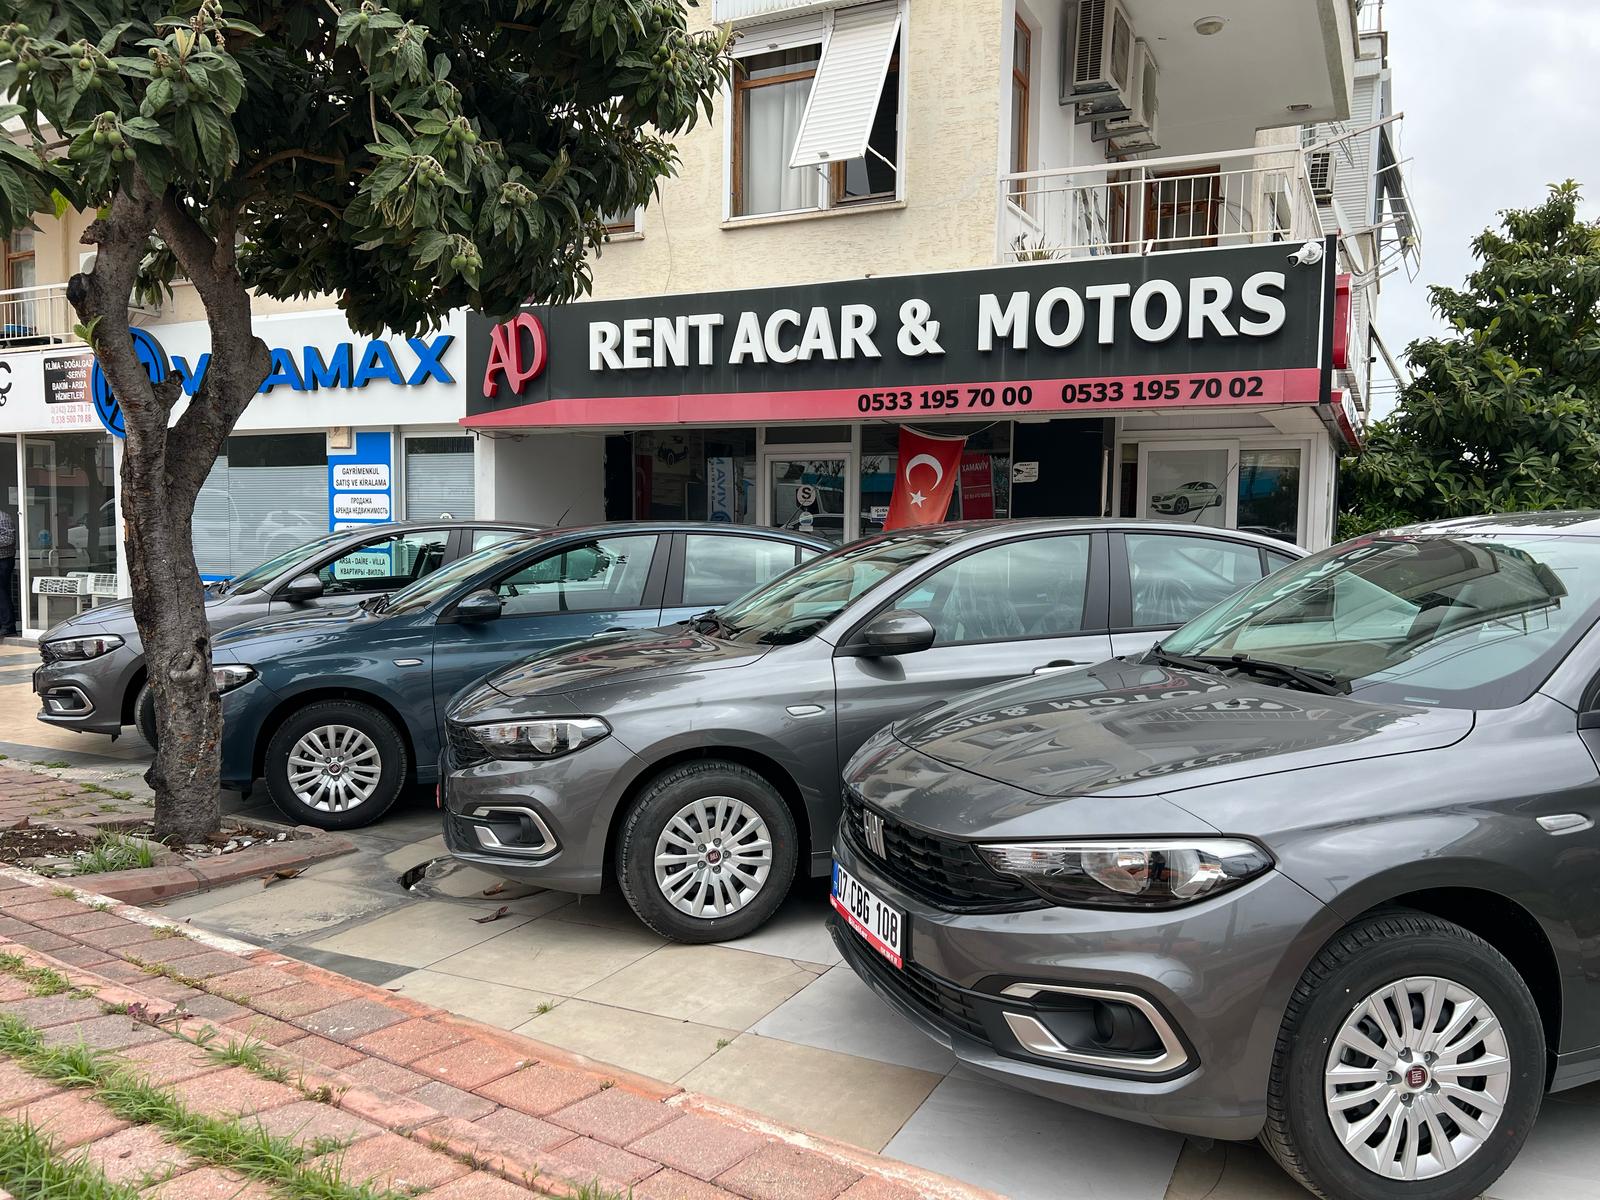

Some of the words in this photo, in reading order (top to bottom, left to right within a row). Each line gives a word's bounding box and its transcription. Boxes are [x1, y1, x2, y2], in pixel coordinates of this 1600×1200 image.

[588, 313, 724, 371] RENT
[728, 303, 882, 365] ACAR
[896, 298, 947, 357] &
[977, 271, 1287, 351] MOTORS
[45, 360, 61, 370] KLİMA
[170, 335, 456, 396] VAMAX
[1061, 381, 1124, 404] 0533
[1132, 379, 1180, 401] 195
[1188, 378, 1222, 399] 70
[1229, 376, 1263, 398] 02
[857, 391, 913, 413] 0533
[918, 389, 959, 410] 195
[967, 387, 995, 407] 70
[1001, 386, 1032, 406] 00
[341, 466, 379, 475] GAYRİMENKUL
[335, 479, 350, 488] SATIŞ
[359, 478, 387, 486] KİRALAMA
[350, 497, 372, 505] ПРОДАЖА
[335, 507, 351, 515] АРЕНДА
[355, 556, 368, 565] DAİRE
[340, 568, 365, 576] КВАРТИРЫ
[837, 867, 848, 903] 07
[850, 880, 870, 925] CBG
[876, 902, 898, 948] 108
